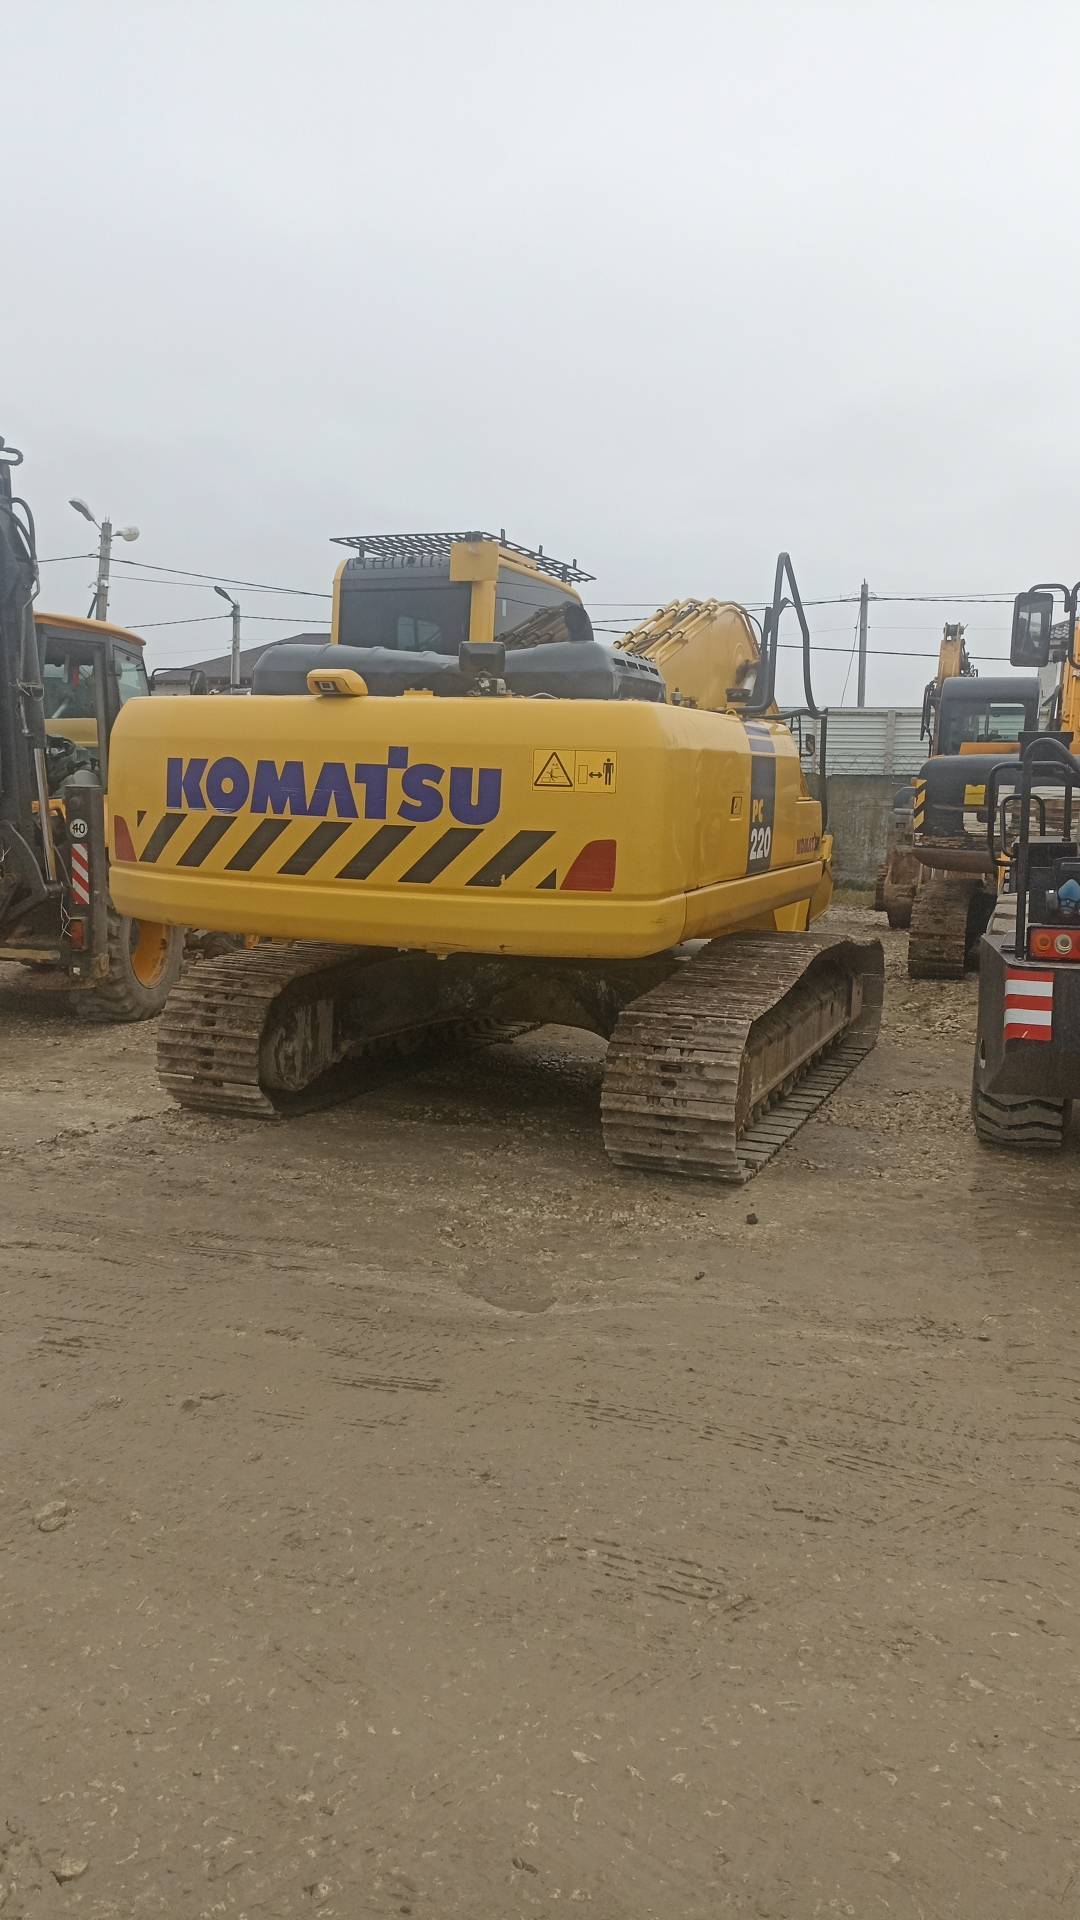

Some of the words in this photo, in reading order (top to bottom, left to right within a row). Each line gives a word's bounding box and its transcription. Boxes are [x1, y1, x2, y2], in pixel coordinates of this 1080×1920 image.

[166, 746, 502, 825] KOMATSU
[752, 798, 764, 823] PC
[72, 823, 85, 834] 40
[749, 826, 771, 860] 220
